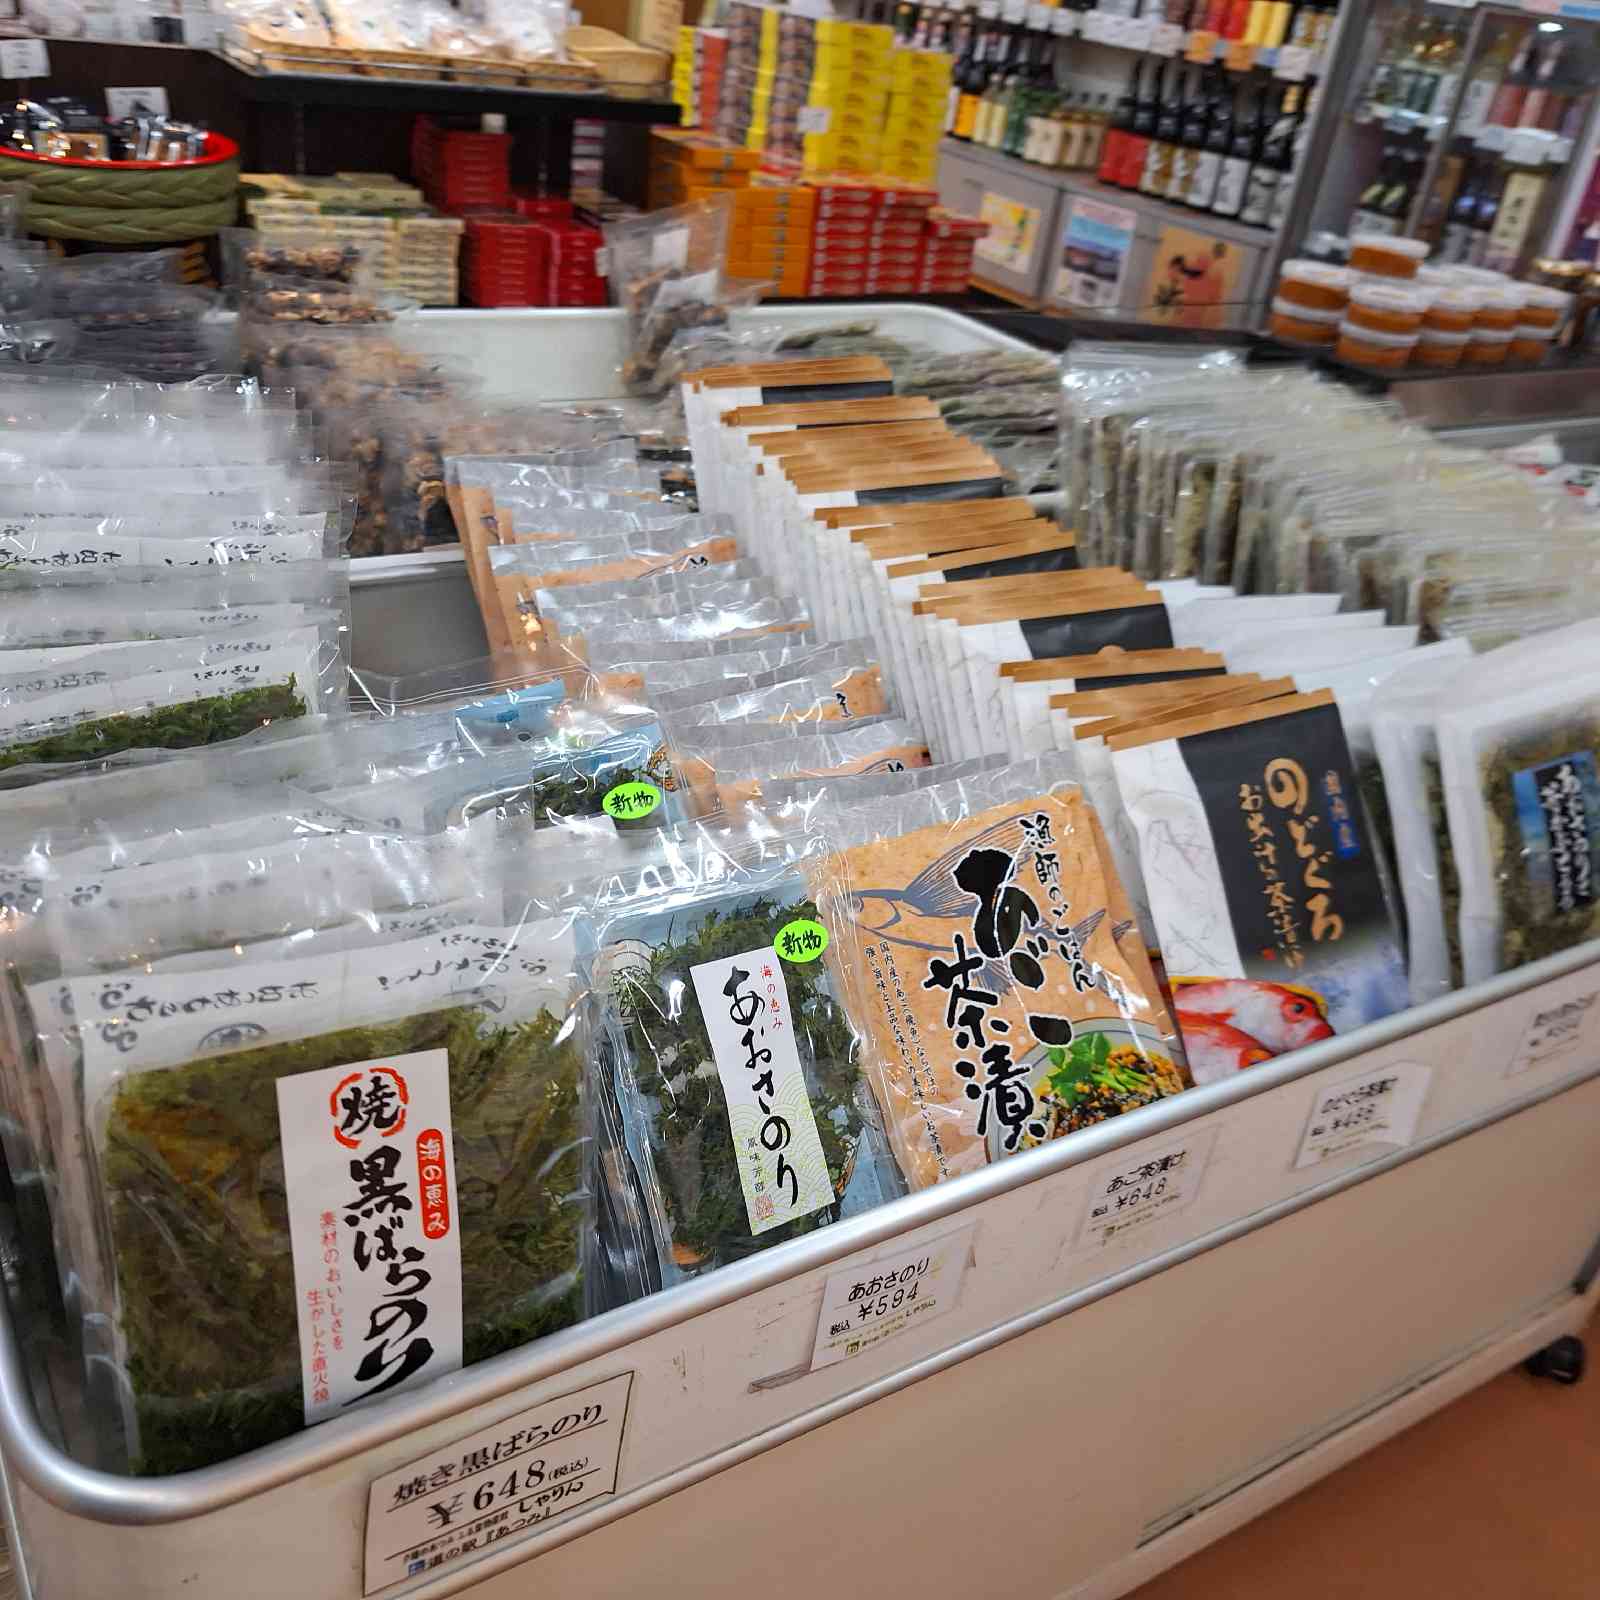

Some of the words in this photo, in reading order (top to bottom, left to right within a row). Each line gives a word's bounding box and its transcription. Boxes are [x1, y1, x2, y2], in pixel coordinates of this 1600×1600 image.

[610, 790, 654, 815] 新物
[1264, 757, 1345, 942] のどぐろ
[781, 929, 823, 956] 新物
[1018, 811, 1096, 993] 漁師のごはん
[760, 965, 784, 1030] 海の恵み
[340, 1075, 400, 1135] 焼
[722, 965, 799, 1208] あおさのり
[418, 1136, 448, 1233] 海の恵み
[319, 1210, 345, 1351] 素材のおいしさを
[341, 1144, 435, 1407] 黒ばらのり
[848, 1256, 931, 1302] あおさのり
[392, 1403, 604, 1505] 焼き黒ばらのり
[517, 1481, 585, 1513] しゃりん
